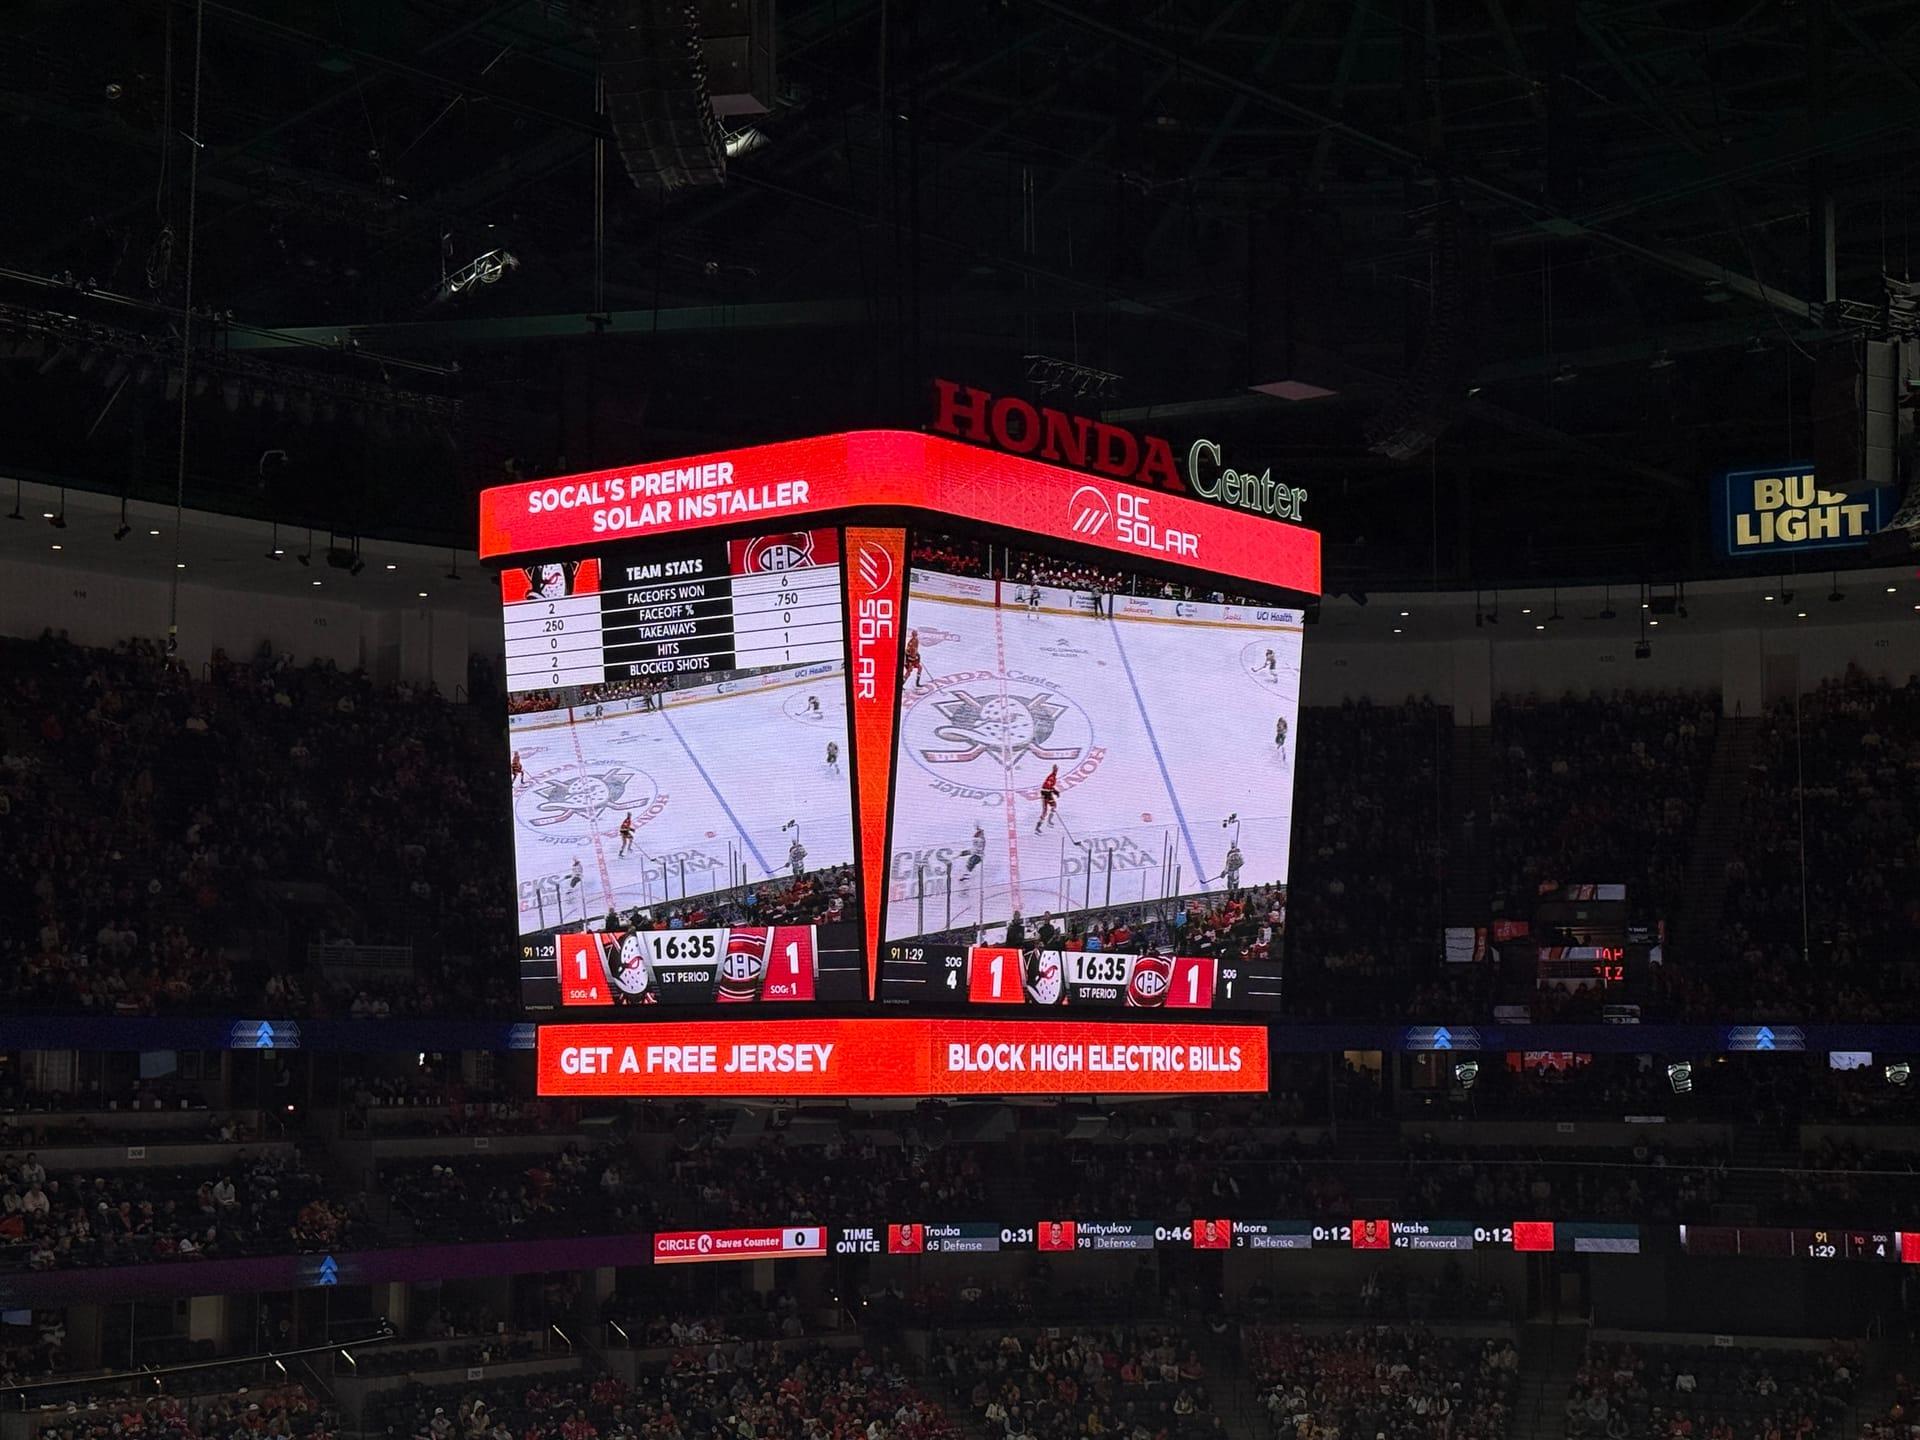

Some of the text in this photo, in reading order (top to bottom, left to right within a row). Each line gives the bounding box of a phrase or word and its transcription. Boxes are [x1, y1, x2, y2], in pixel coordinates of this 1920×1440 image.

[934, 379, 1308, 521] HONDA Center
[528, 462, 734, 513] SOCAL'S PREMIER
[592, 480, 809, 533] SOLAR INSTALLER
[1116, 492, 1150, 522] OC
[1736, 503, 1870, 546] LIGHT
[1116, 519, 1199, 558] SOLAR
[626, 559, 703, 581] TEAM STATS
[781, 575, 788, 587] 6
[627, 584, 705, 605] FACEOFFS WON
[774, 592, 798, 607] .750
[548, 603, 555, 615] 2
[639, 604, 695, 621] FACEOFF %
[784, 611, 791, 624] 0
[877, 599, 893, 638] OC
[543, 620, 564, 633] .250
[639, 622, 697, 640] TAKEAWAYS
[551, 638, 558, 650] 0
[784, 632, 789, 643] 1
[657, 643, 680, 657] HITS
[785, 650, 790, 661] 1
[858, 598, 877, 699] SOLAR
[552, 657, 558, 668] 2
[630, 657, 710, 676] BLOCKED SHOTS
[552, 673, 559, 685] 0
[523, 945, 555, 958] 91 1:29
[653, 934, 715, 959] 16:35
[785, 941, 799, 975] 1
[891, 948, 923, 960] 91 1:29
[575, 949, 588, 980] 1
[945, 957, 962, 968] SOG
[1076, 956, 1126, 981] 16:35
[662, 971, 710, 983] 1ST PERIOD
[946, 970, 958, 990] 4
[990, 955, 1004, 998] 1
[1222, 969, 1238, 979] SOG
[791, 982, 797, 995] 1
[1187, 963, 1199, 1004] 1
[1226, 981, 1232, 999] 1
[589, 987, 597, 1000] 4
[1079, 987, 1117, 999] 1ST PERIOD
[560, 1044, 834, 1074] GET A FREE JERSEY
[948, 1043, 1242, 1072] BLOCK HIGH ELECTRIC BILLS
[843, 1228, 874, 1241] TIME
[924, 1225, 961, 1237] Trouba
[1077, 1223, 1132, 1236] Mintyukov
[1155, 1227, 1192, 1241] 0:46
[1232, 1222, 1267, 1233] Moore
[1312, 1227, 1351, 1241] 0:12
[1391, 1222, 1429, 1234] Washe
[1474, 1227, 1513, 1242] 0:12
[794, 1231, 806, 1246] 0
[1001, 1228, 1034, 1243] 0:31
[1077, 1237, 1137, 1248] 98 Defense
[1236, 1237, 1294, 1248] 3 Defense
[1815, 1231, 1828, 1243] 91
[658, 1236, 780, 1251] CIRCLE K Saves Counter
[836, 1240, 881, 1254] ON ICE
[926, 1240, 983, 1251] 65 Defense
[1394, 1237, 1457, 1249] 42 Forward
[1808, 1244, 1836, 1257] 1:29
[1876, 1244, 1886, 1257] 4
